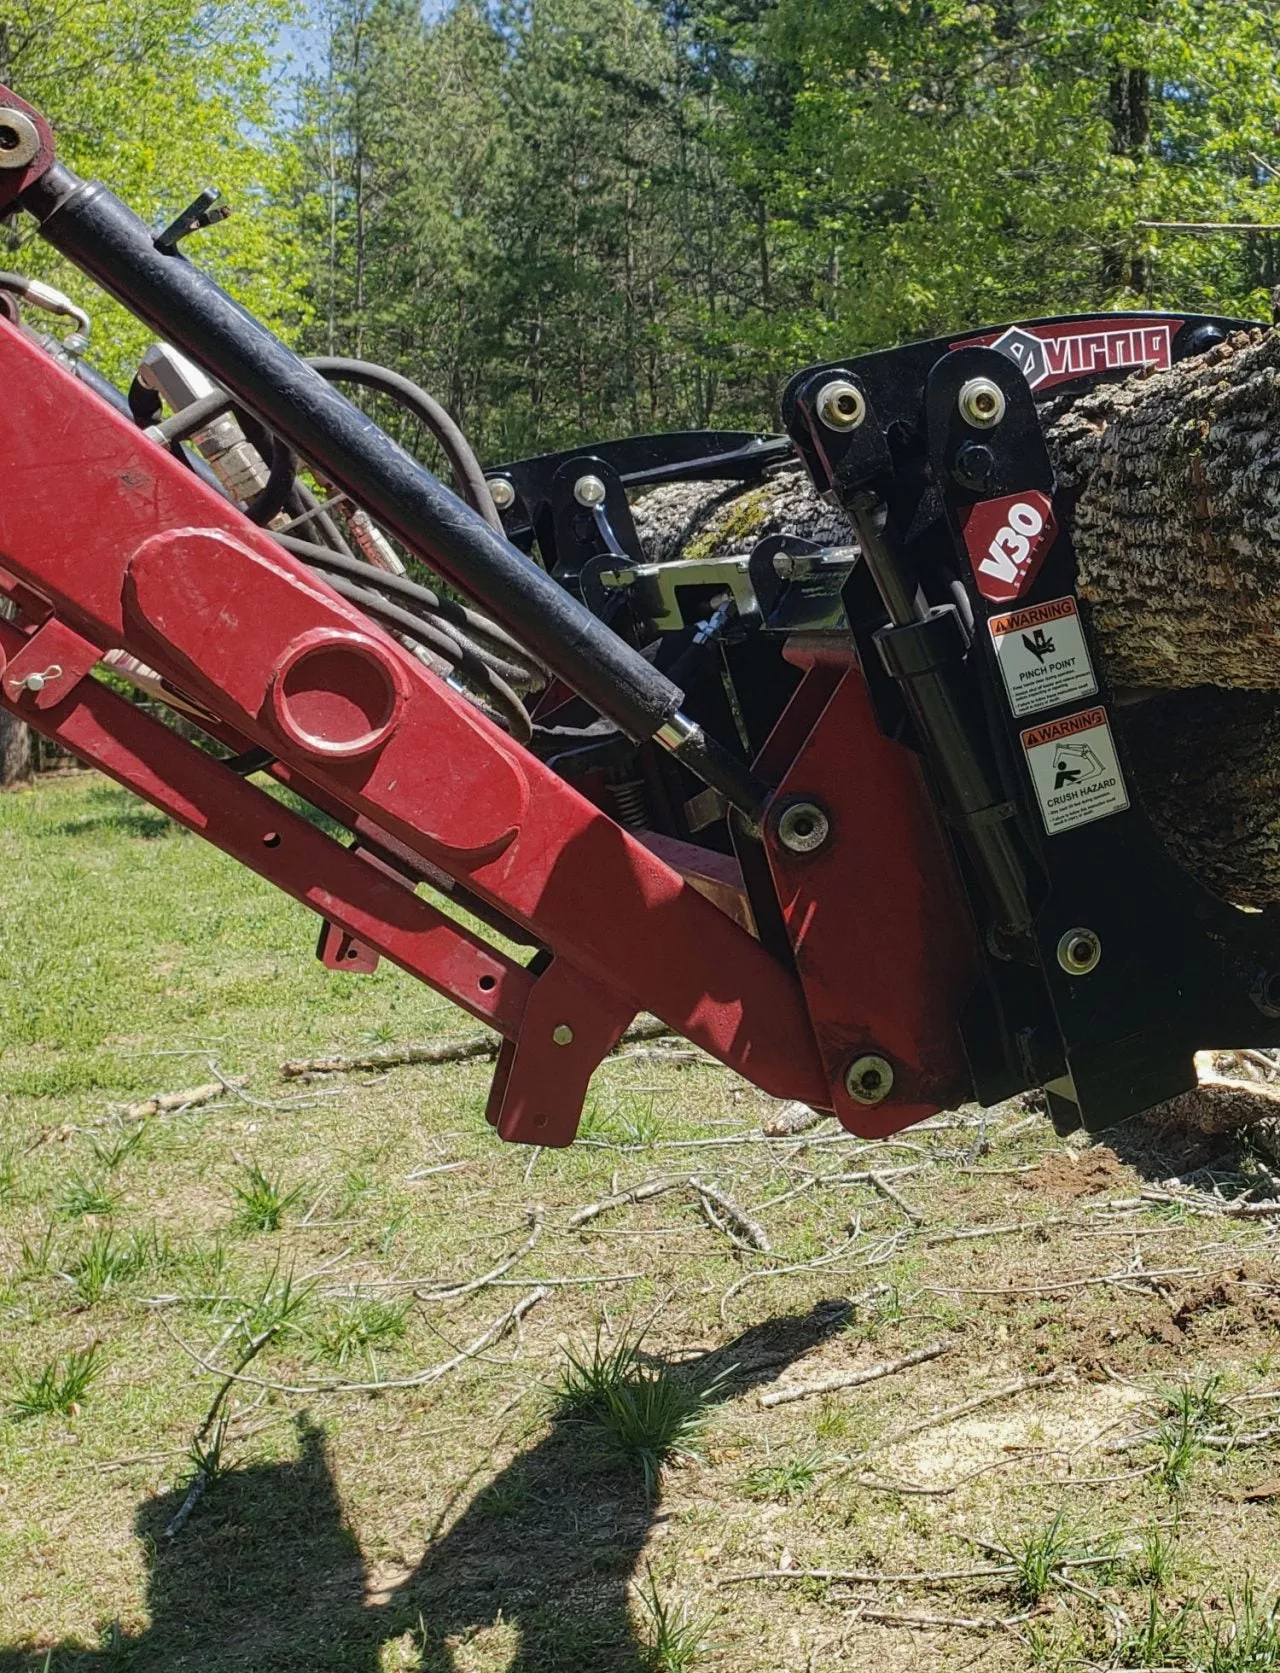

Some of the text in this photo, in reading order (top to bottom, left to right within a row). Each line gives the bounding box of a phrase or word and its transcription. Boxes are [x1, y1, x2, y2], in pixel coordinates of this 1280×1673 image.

[978, 502, 1043, 584] V30
[1006, 600, 1072, 630] WARNING
[1019, 666, 1048, 681] PINCH
[1049, 657, 1076, 672] POINT
[1037, 711, 1102, 740] WARNING
[1047, 790, 1079, 808] CRUSH
[1080, 777, 1117, 797] HAZARD
